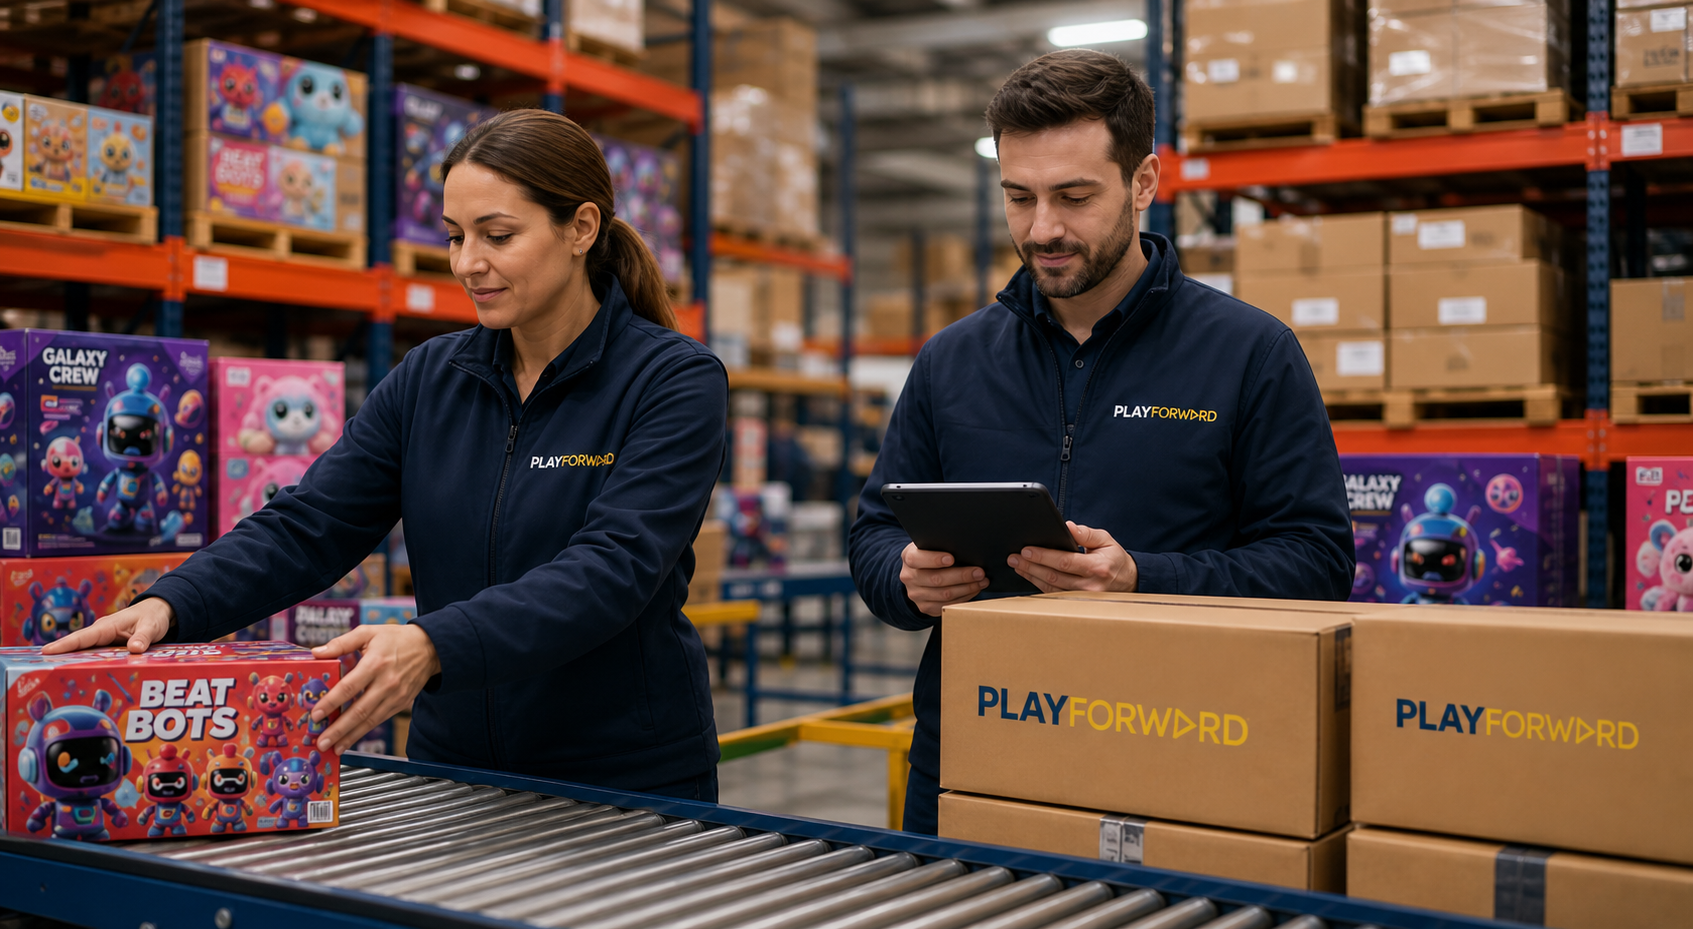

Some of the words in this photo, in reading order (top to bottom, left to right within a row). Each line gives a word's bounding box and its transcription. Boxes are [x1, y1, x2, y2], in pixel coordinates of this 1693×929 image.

[42, 347, 108, 368] GALAXY
[49, 366, 99, 385] CREW
[139, 677, 237, 709] BEAT
[125, 706, 239, 743] BOTS
